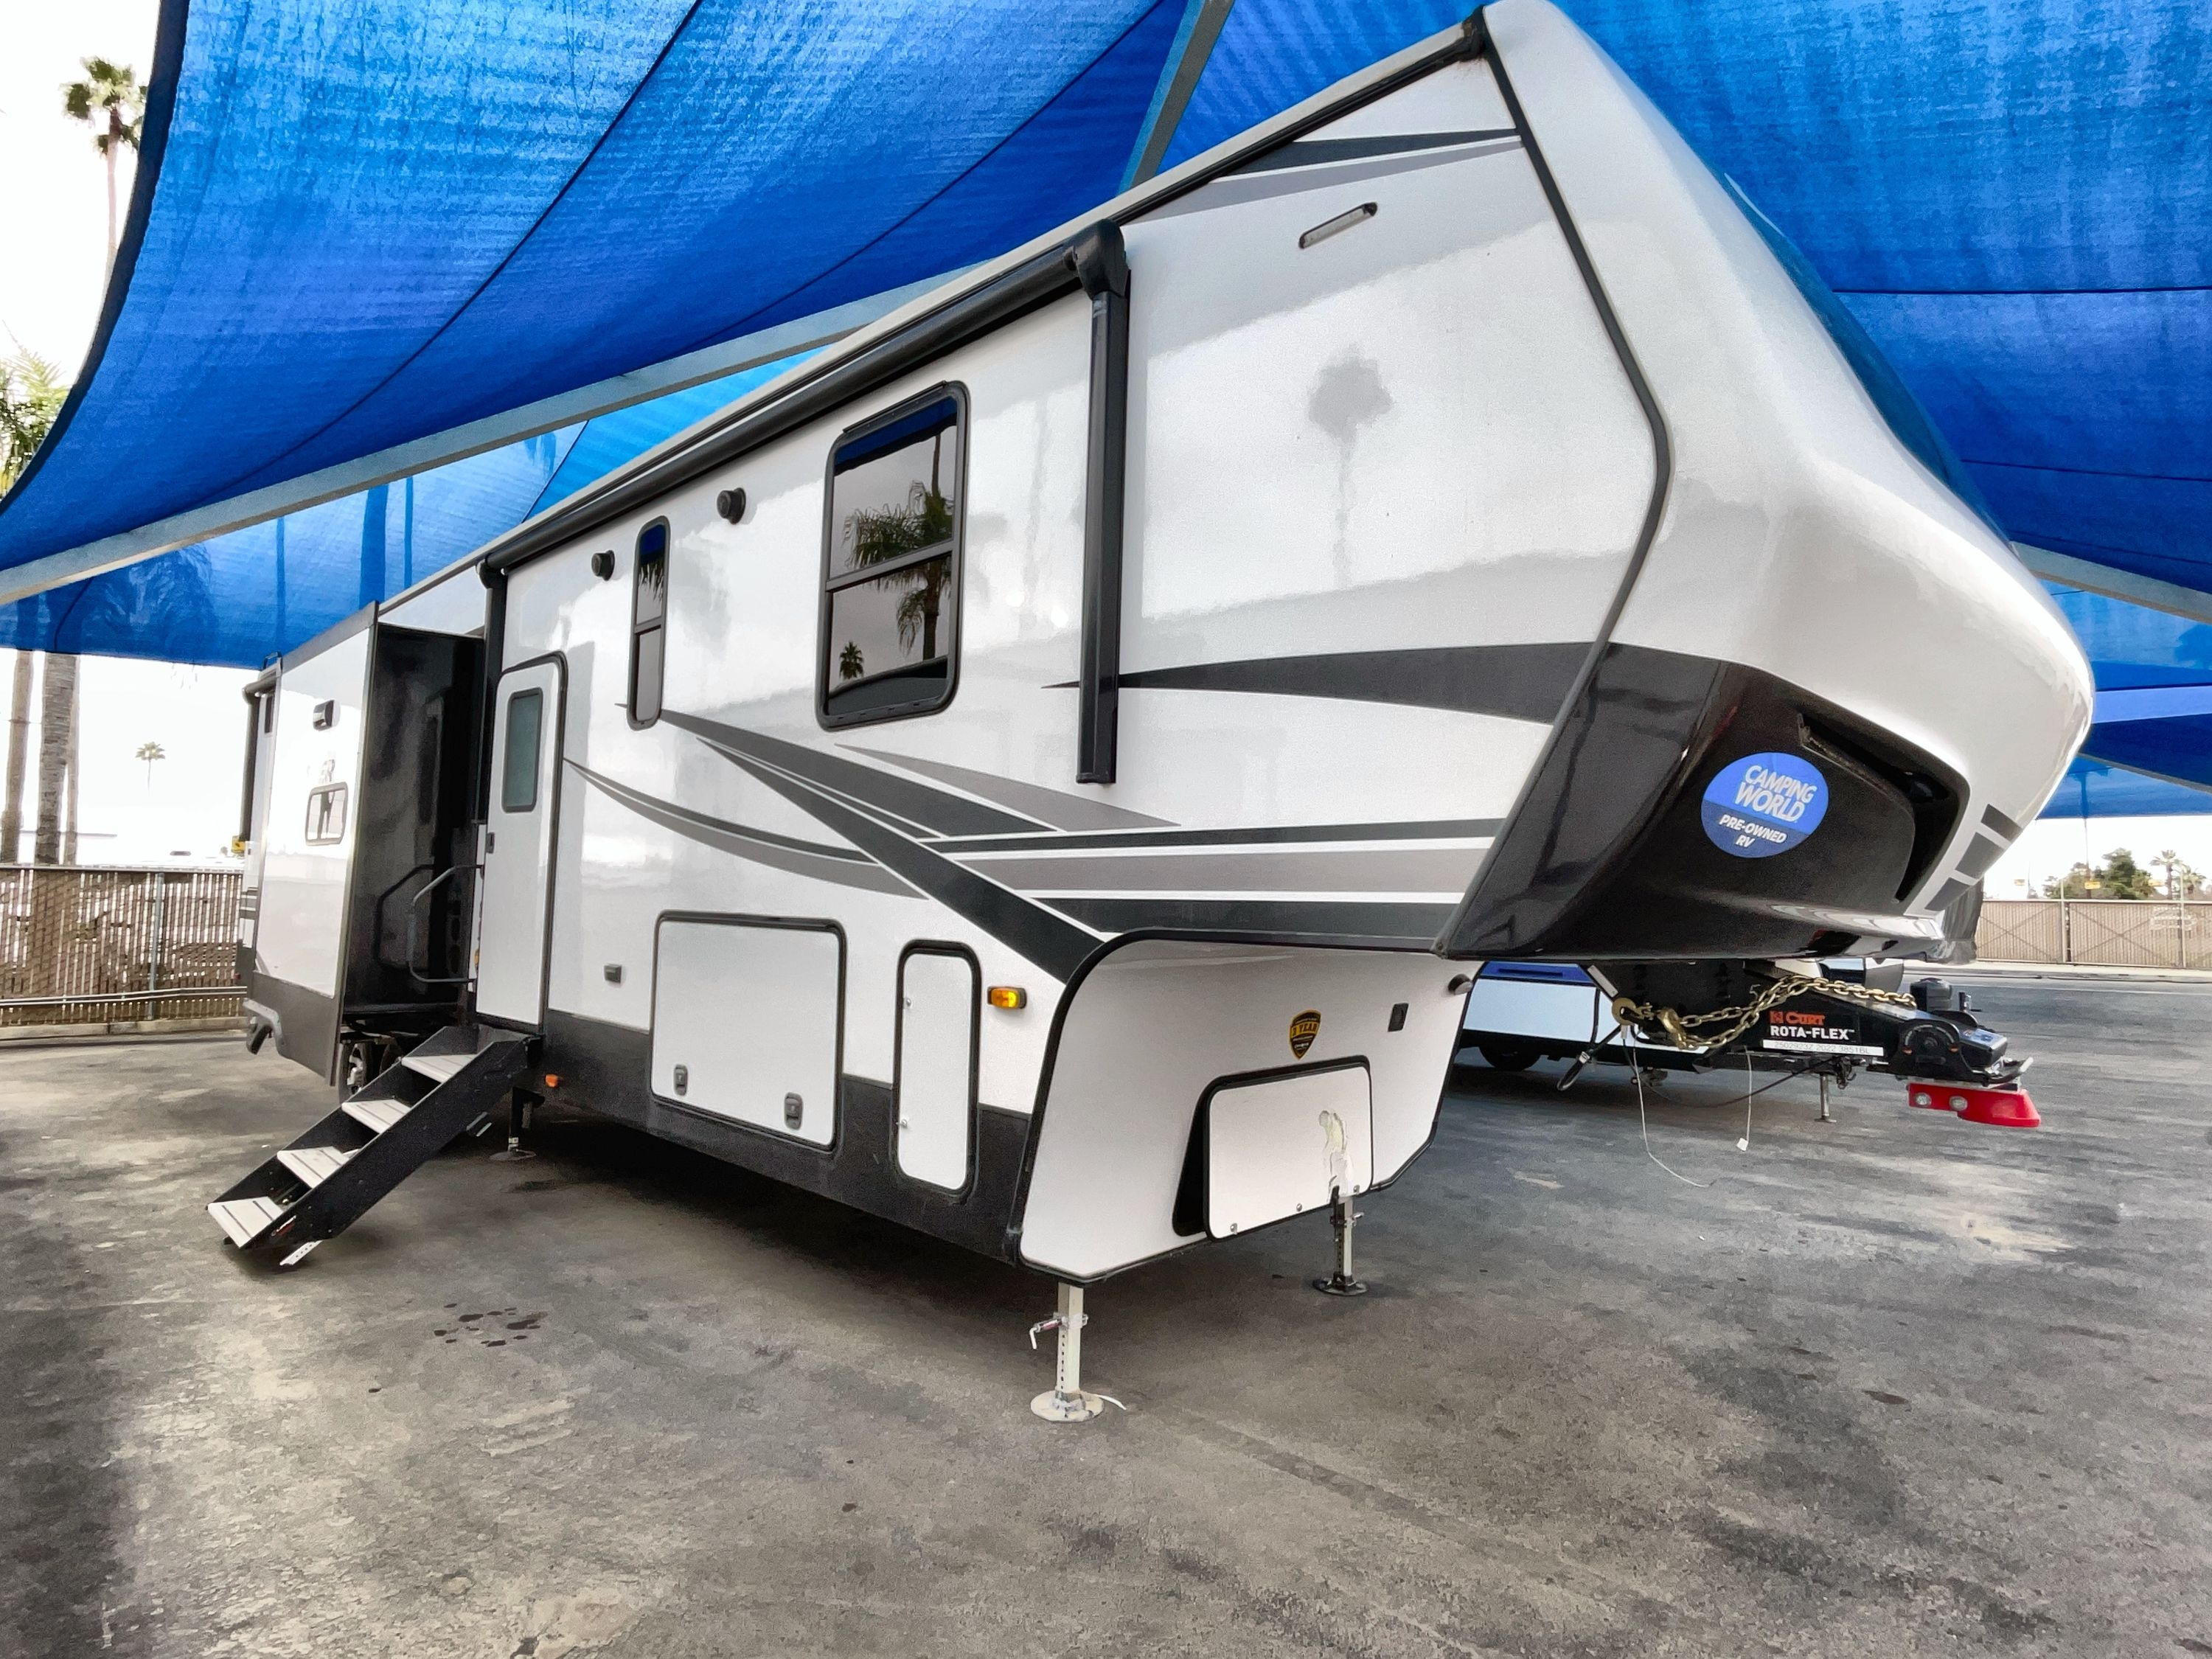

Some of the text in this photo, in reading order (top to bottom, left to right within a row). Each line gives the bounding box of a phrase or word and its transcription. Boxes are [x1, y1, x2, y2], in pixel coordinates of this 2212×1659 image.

[1745, 765, 1817, 803] CAMPING
[1734, 782, 1805, 822] WORLD
[1719, 814, 1787, 844] PRE-OWNED
[1735, 835, 1756, 847] RV
[1299, 1023, 1318, 1033] YEAR
